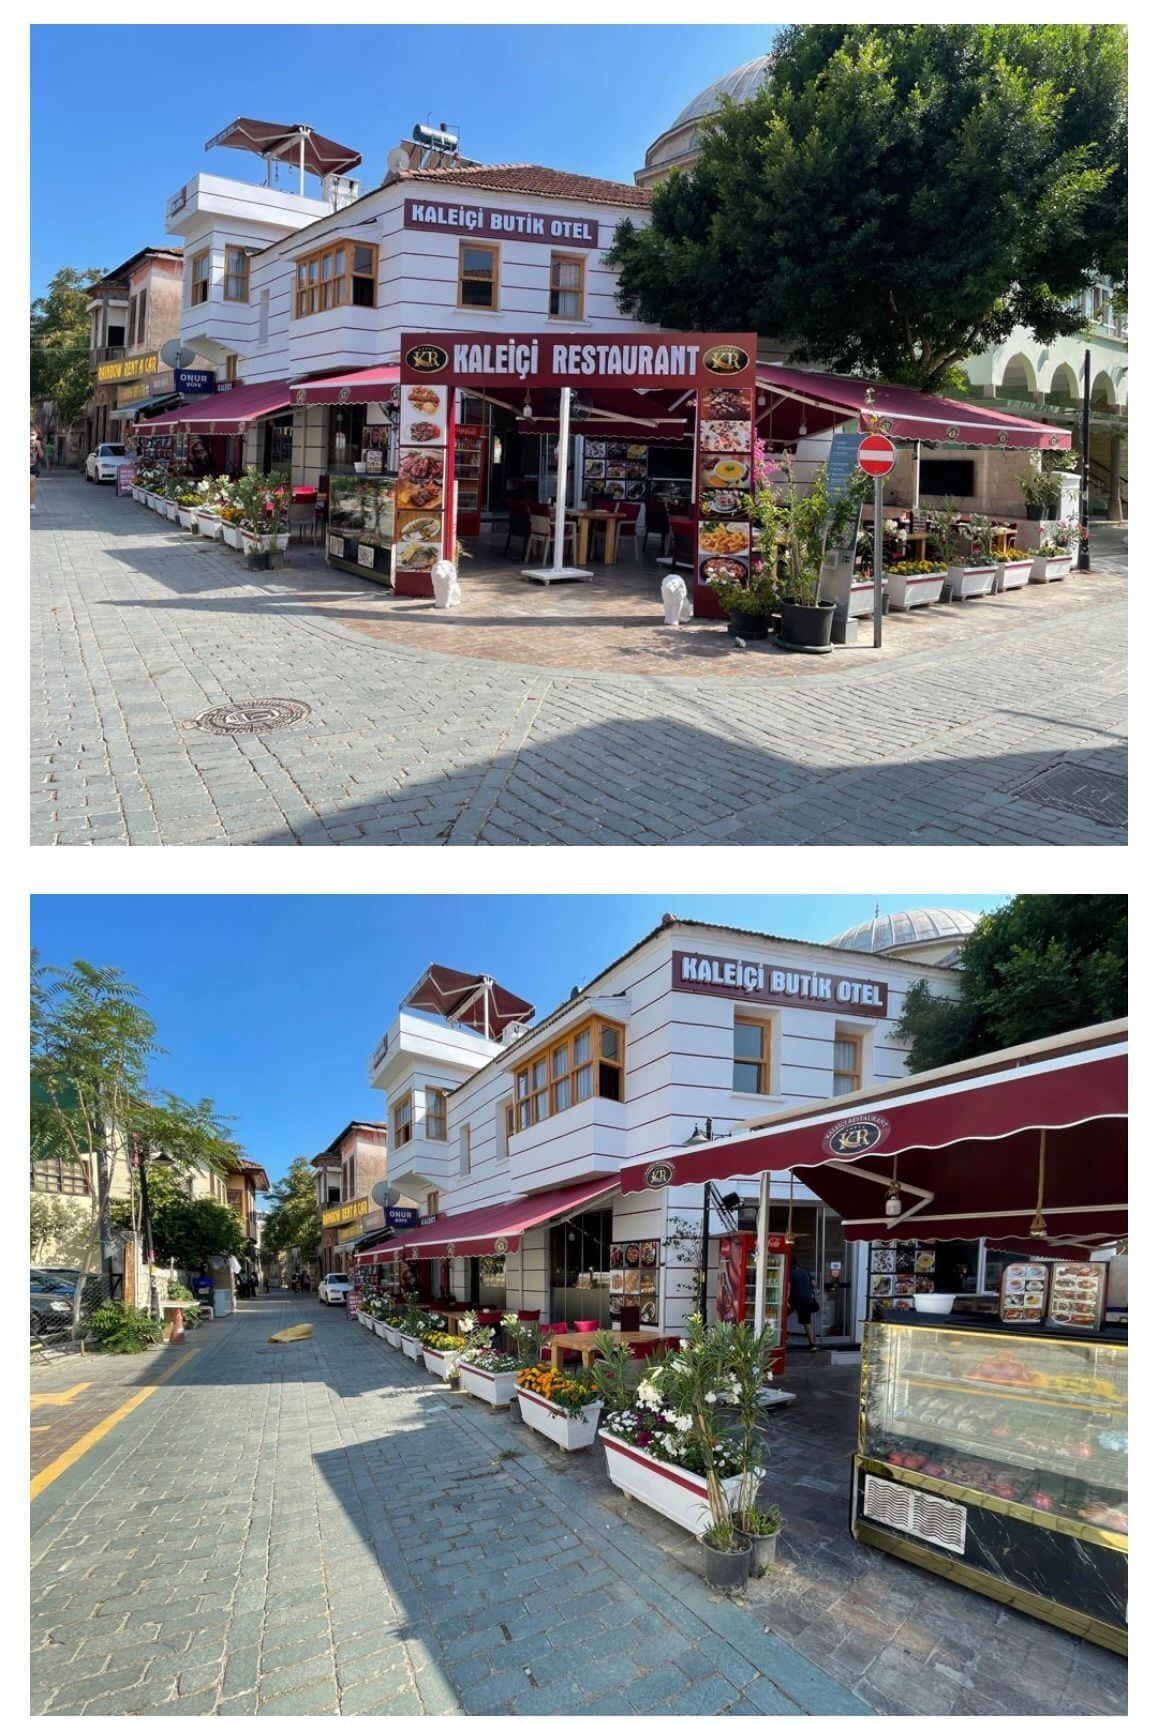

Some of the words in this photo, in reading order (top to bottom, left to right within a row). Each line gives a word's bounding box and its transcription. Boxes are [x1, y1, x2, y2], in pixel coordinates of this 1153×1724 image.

[412, 204, 483, 230] KALEİÇİ
[491, 212, 544, 235] BUTİK
[551, 221, 592, 240] OTEL
[453, 338, 539, 380] KALEİÇİ
[552, 345, 699, 375] RESTAURANT
[180, 374, 208, 382] ONUR
[682, 957, 764, 993] KALEİÇİ
[770, 971, 832, 998] BUTİK
[837, 983, 883, 1007] OTEL
[389, 1210, 412, 1218] ONUR
